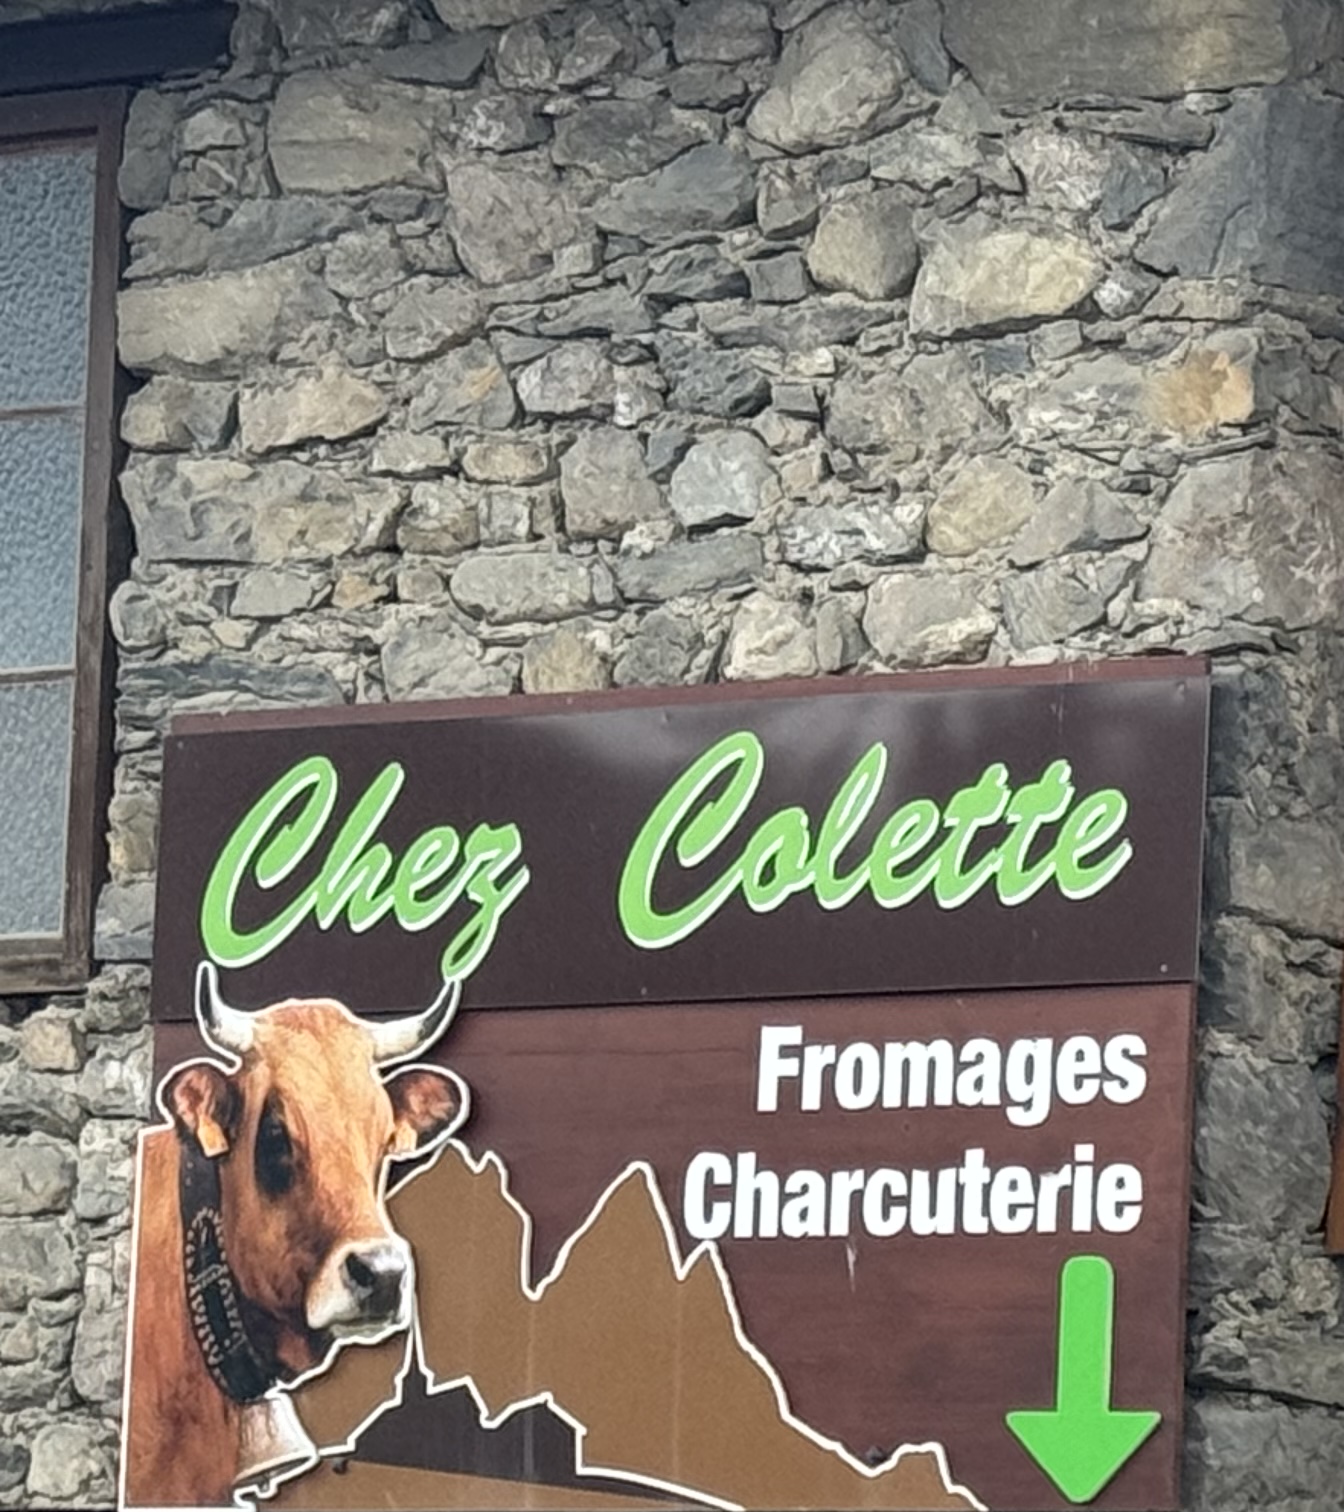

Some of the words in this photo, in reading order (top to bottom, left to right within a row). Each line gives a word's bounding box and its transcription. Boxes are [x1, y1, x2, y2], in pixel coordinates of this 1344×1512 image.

[201, 757, 531, 981] Chez
[617, 731, 1132, 949] Colette
[756, 1026, 1148, 1125] Fromages
[684, 1146, 1144, 1241] Charcuterie
